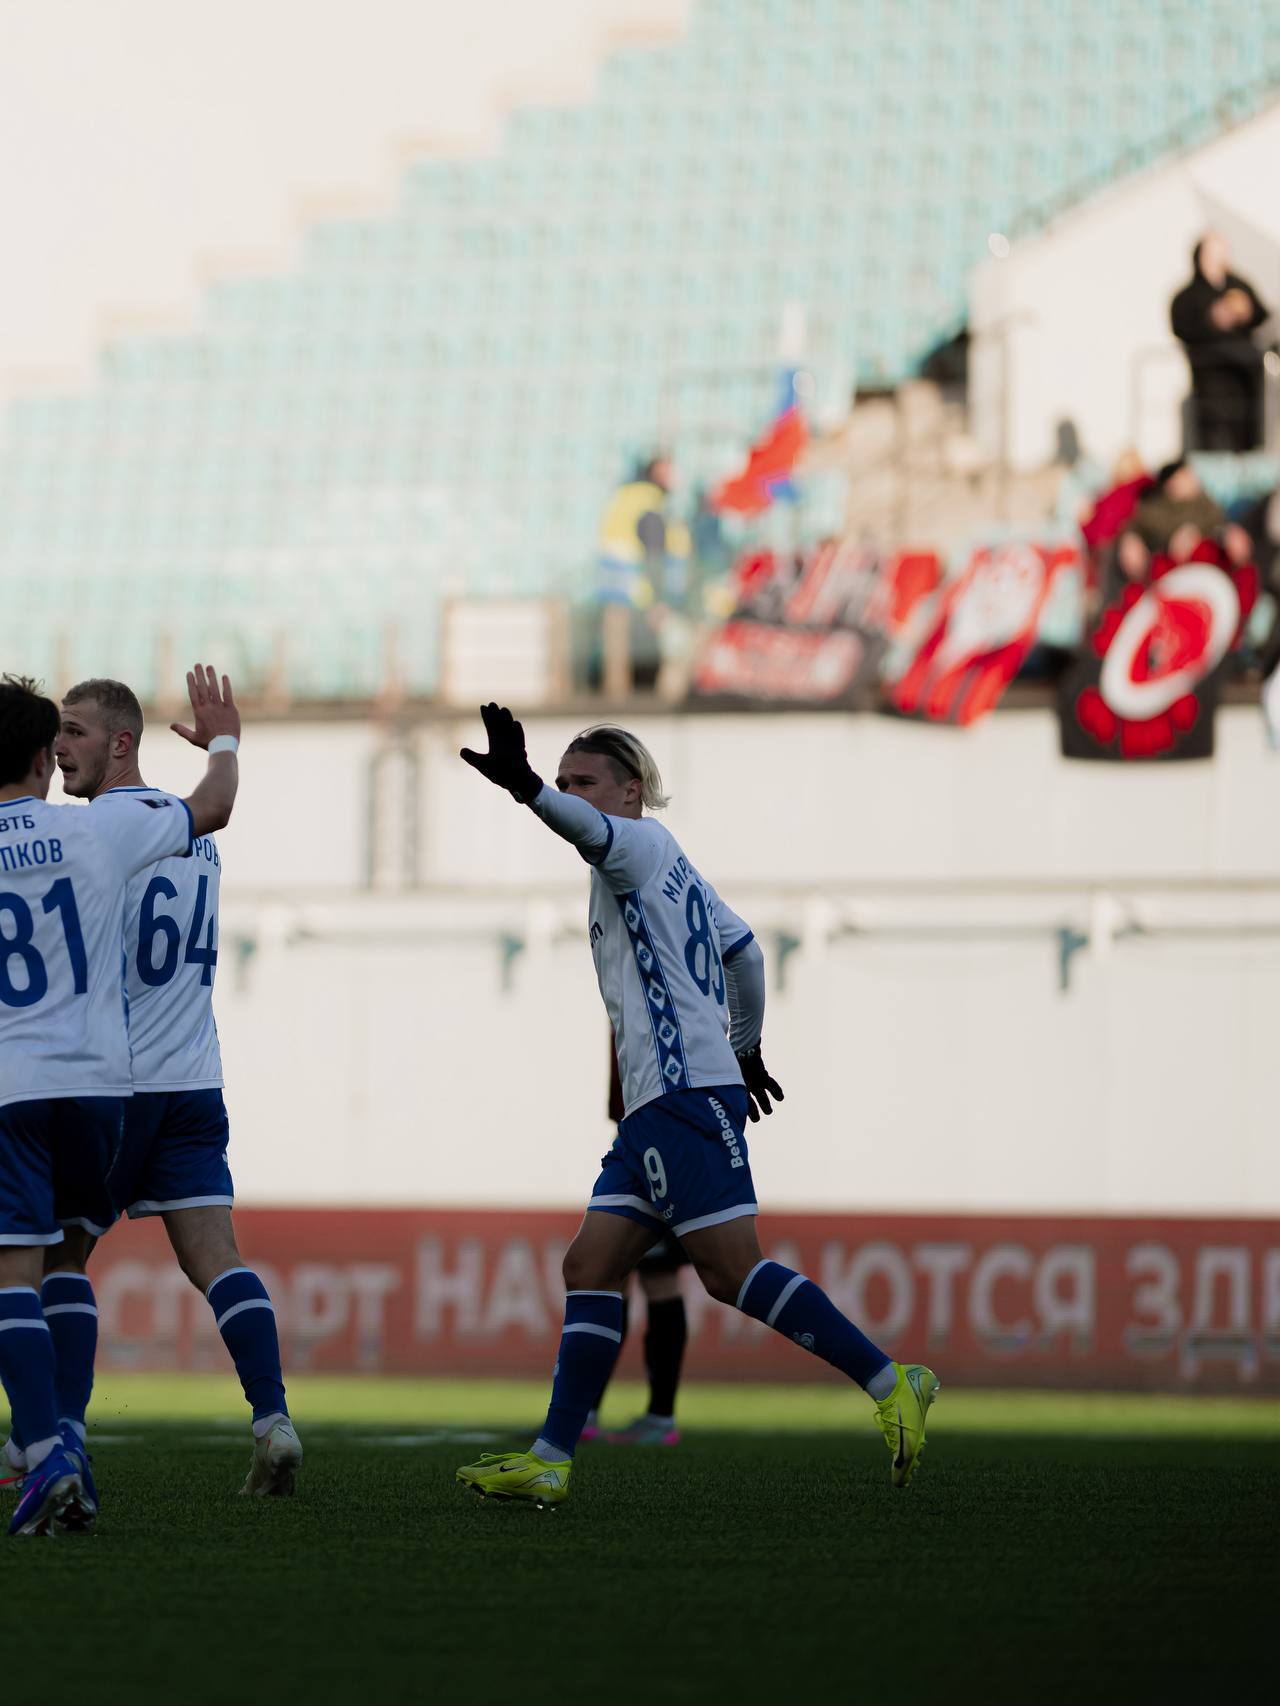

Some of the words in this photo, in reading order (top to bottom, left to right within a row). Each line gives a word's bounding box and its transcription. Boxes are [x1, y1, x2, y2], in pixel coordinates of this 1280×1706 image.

[193, 836, 219, 867] РОВ
[136, 874, 217, 987] 64
[708, 1096, 744, 1169] BetBoom
